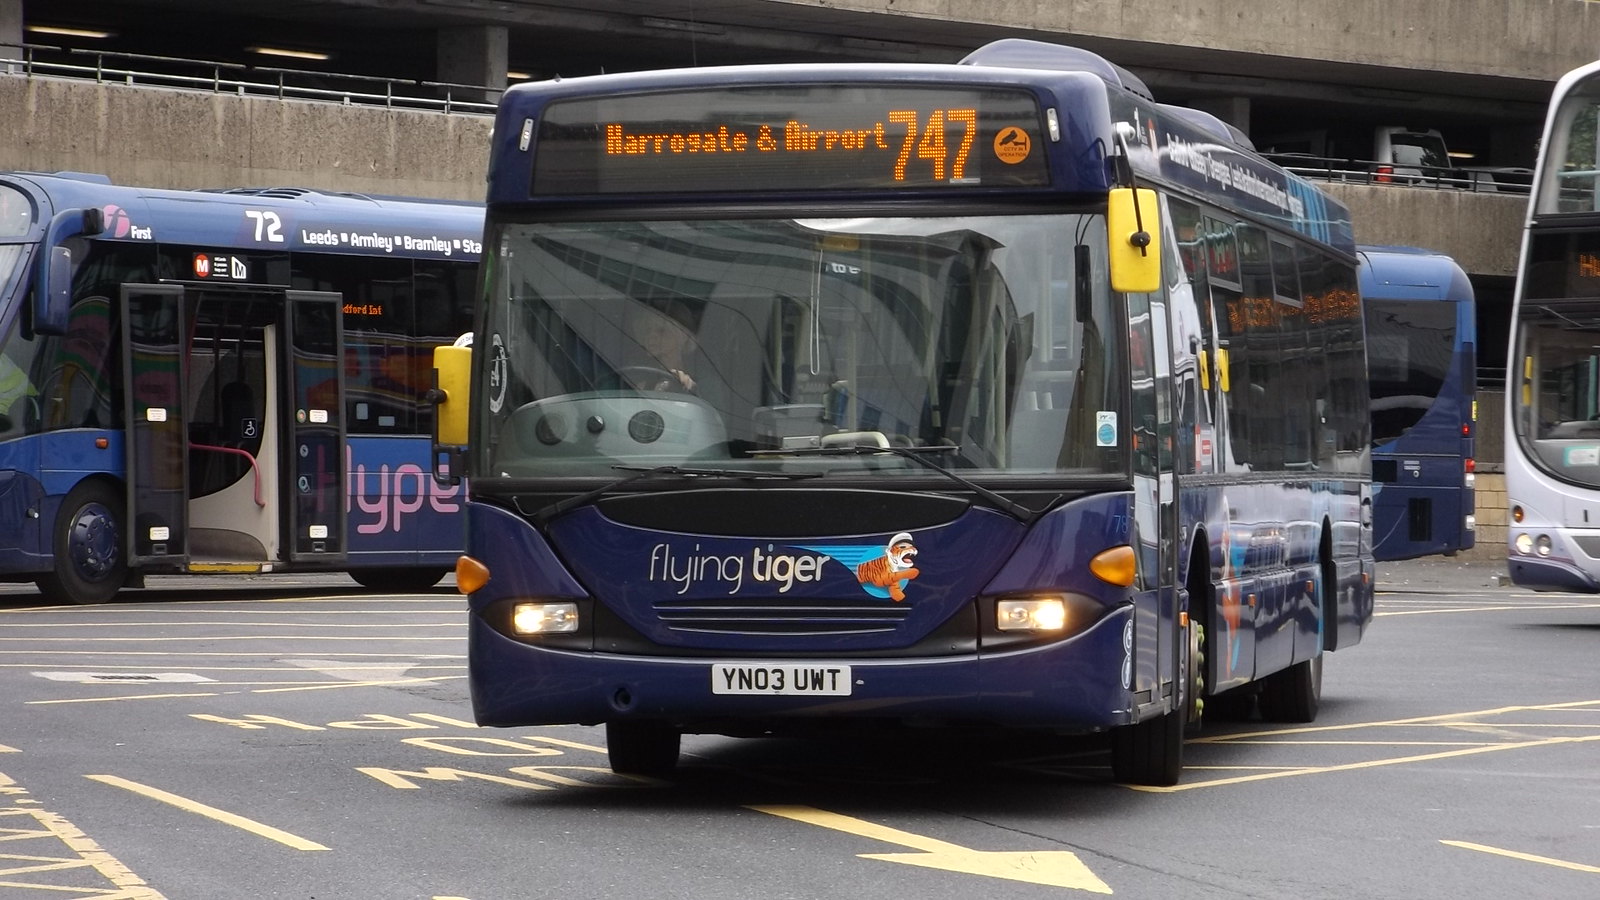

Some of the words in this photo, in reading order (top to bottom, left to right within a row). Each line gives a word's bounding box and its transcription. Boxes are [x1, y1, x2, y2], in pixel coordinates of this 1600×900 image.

[606, 123, 748, 154] Harrogate
[757, 125, 777, 151] &
[785, 120, 889, 151] Airport
[888, 109, 977, 180] 747
[131, 225, 152, 240] First
[245, 210, 285, 243] 72
[302, 229, 339, 246] Leeds
[350, 232, 393, 253] Armley
[403, 235, 452, 256] Bramley
[462, 238, 483, 254] Sta
[196, 259, 209, 273] M
[649, 543, 744, 595] flying
[752, 543, 831, 594] tiger
[722, 667, 785, 691] YN03
[794, 668, 841, 691] UWT
